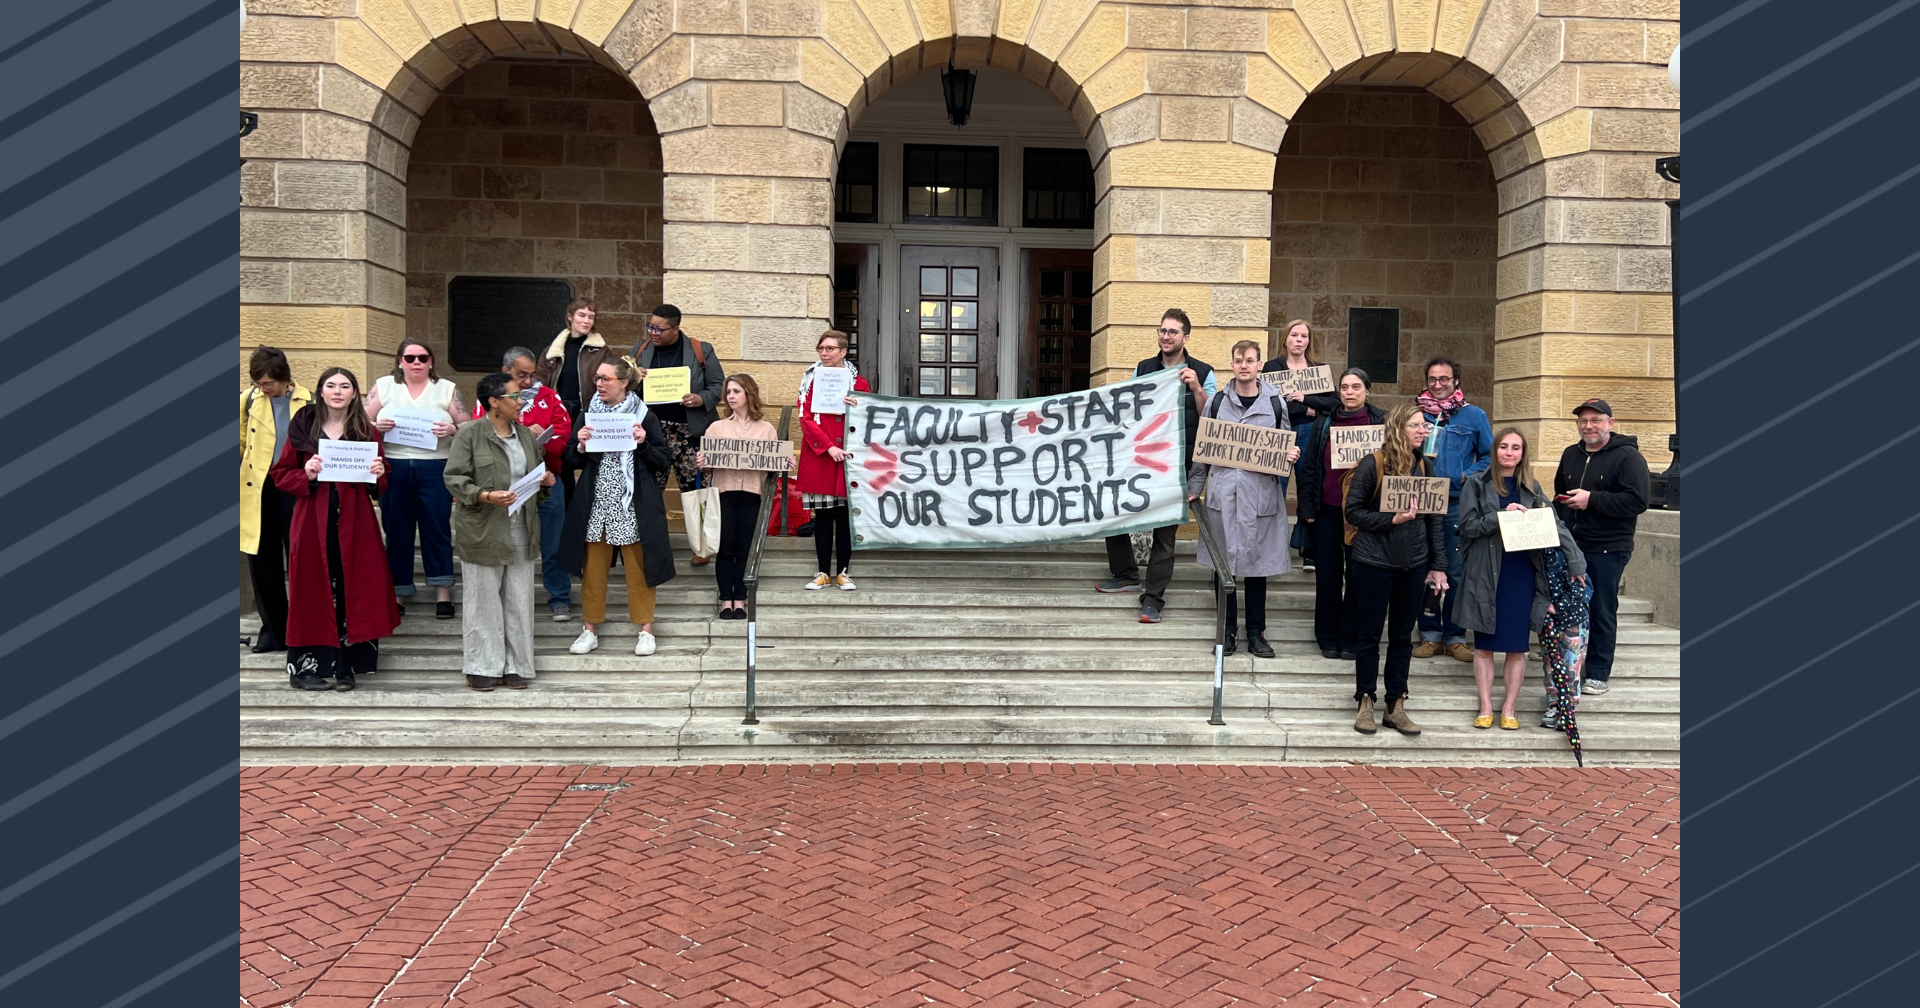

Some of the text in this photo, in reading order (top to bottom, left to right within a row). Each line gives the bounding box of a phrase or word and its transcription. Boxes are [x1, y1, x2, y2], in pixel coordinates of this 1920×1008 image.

[1297, 368, 1320, 380] STAFF
[1293, 378, 1329, 391] STUDENTS
[863, 405, 1019, 447] FACULTY
[1038, 383, 1157, 435] STAFF
[1223, 424, 1261, 446] FACULTY
[1264, 431, 1292, 450] STAFF
[1336, 429, 1384, 444] HANDS OF
[703, 438, 717, 451] UW
[719, 439, 750, 453] FACULTY
[755, 441, 783, 453] STAFF
[1197, 441, 1235, 460] SUPPORT
[1237, 447, 1252, 463] OUR
[703, 452, 740, 468] SUPPORT
[749, 454, 790, 470] STUDENTS
[899, 432, 1125, 486] SUPPORT
[1413, 478, 1430, 492] OFF
[878, 473, 1152, 528] OUR STUDENTS
[1517, 523, 1537, 534] OUR
[1508, 533, 1556, 548] STUDENTS
